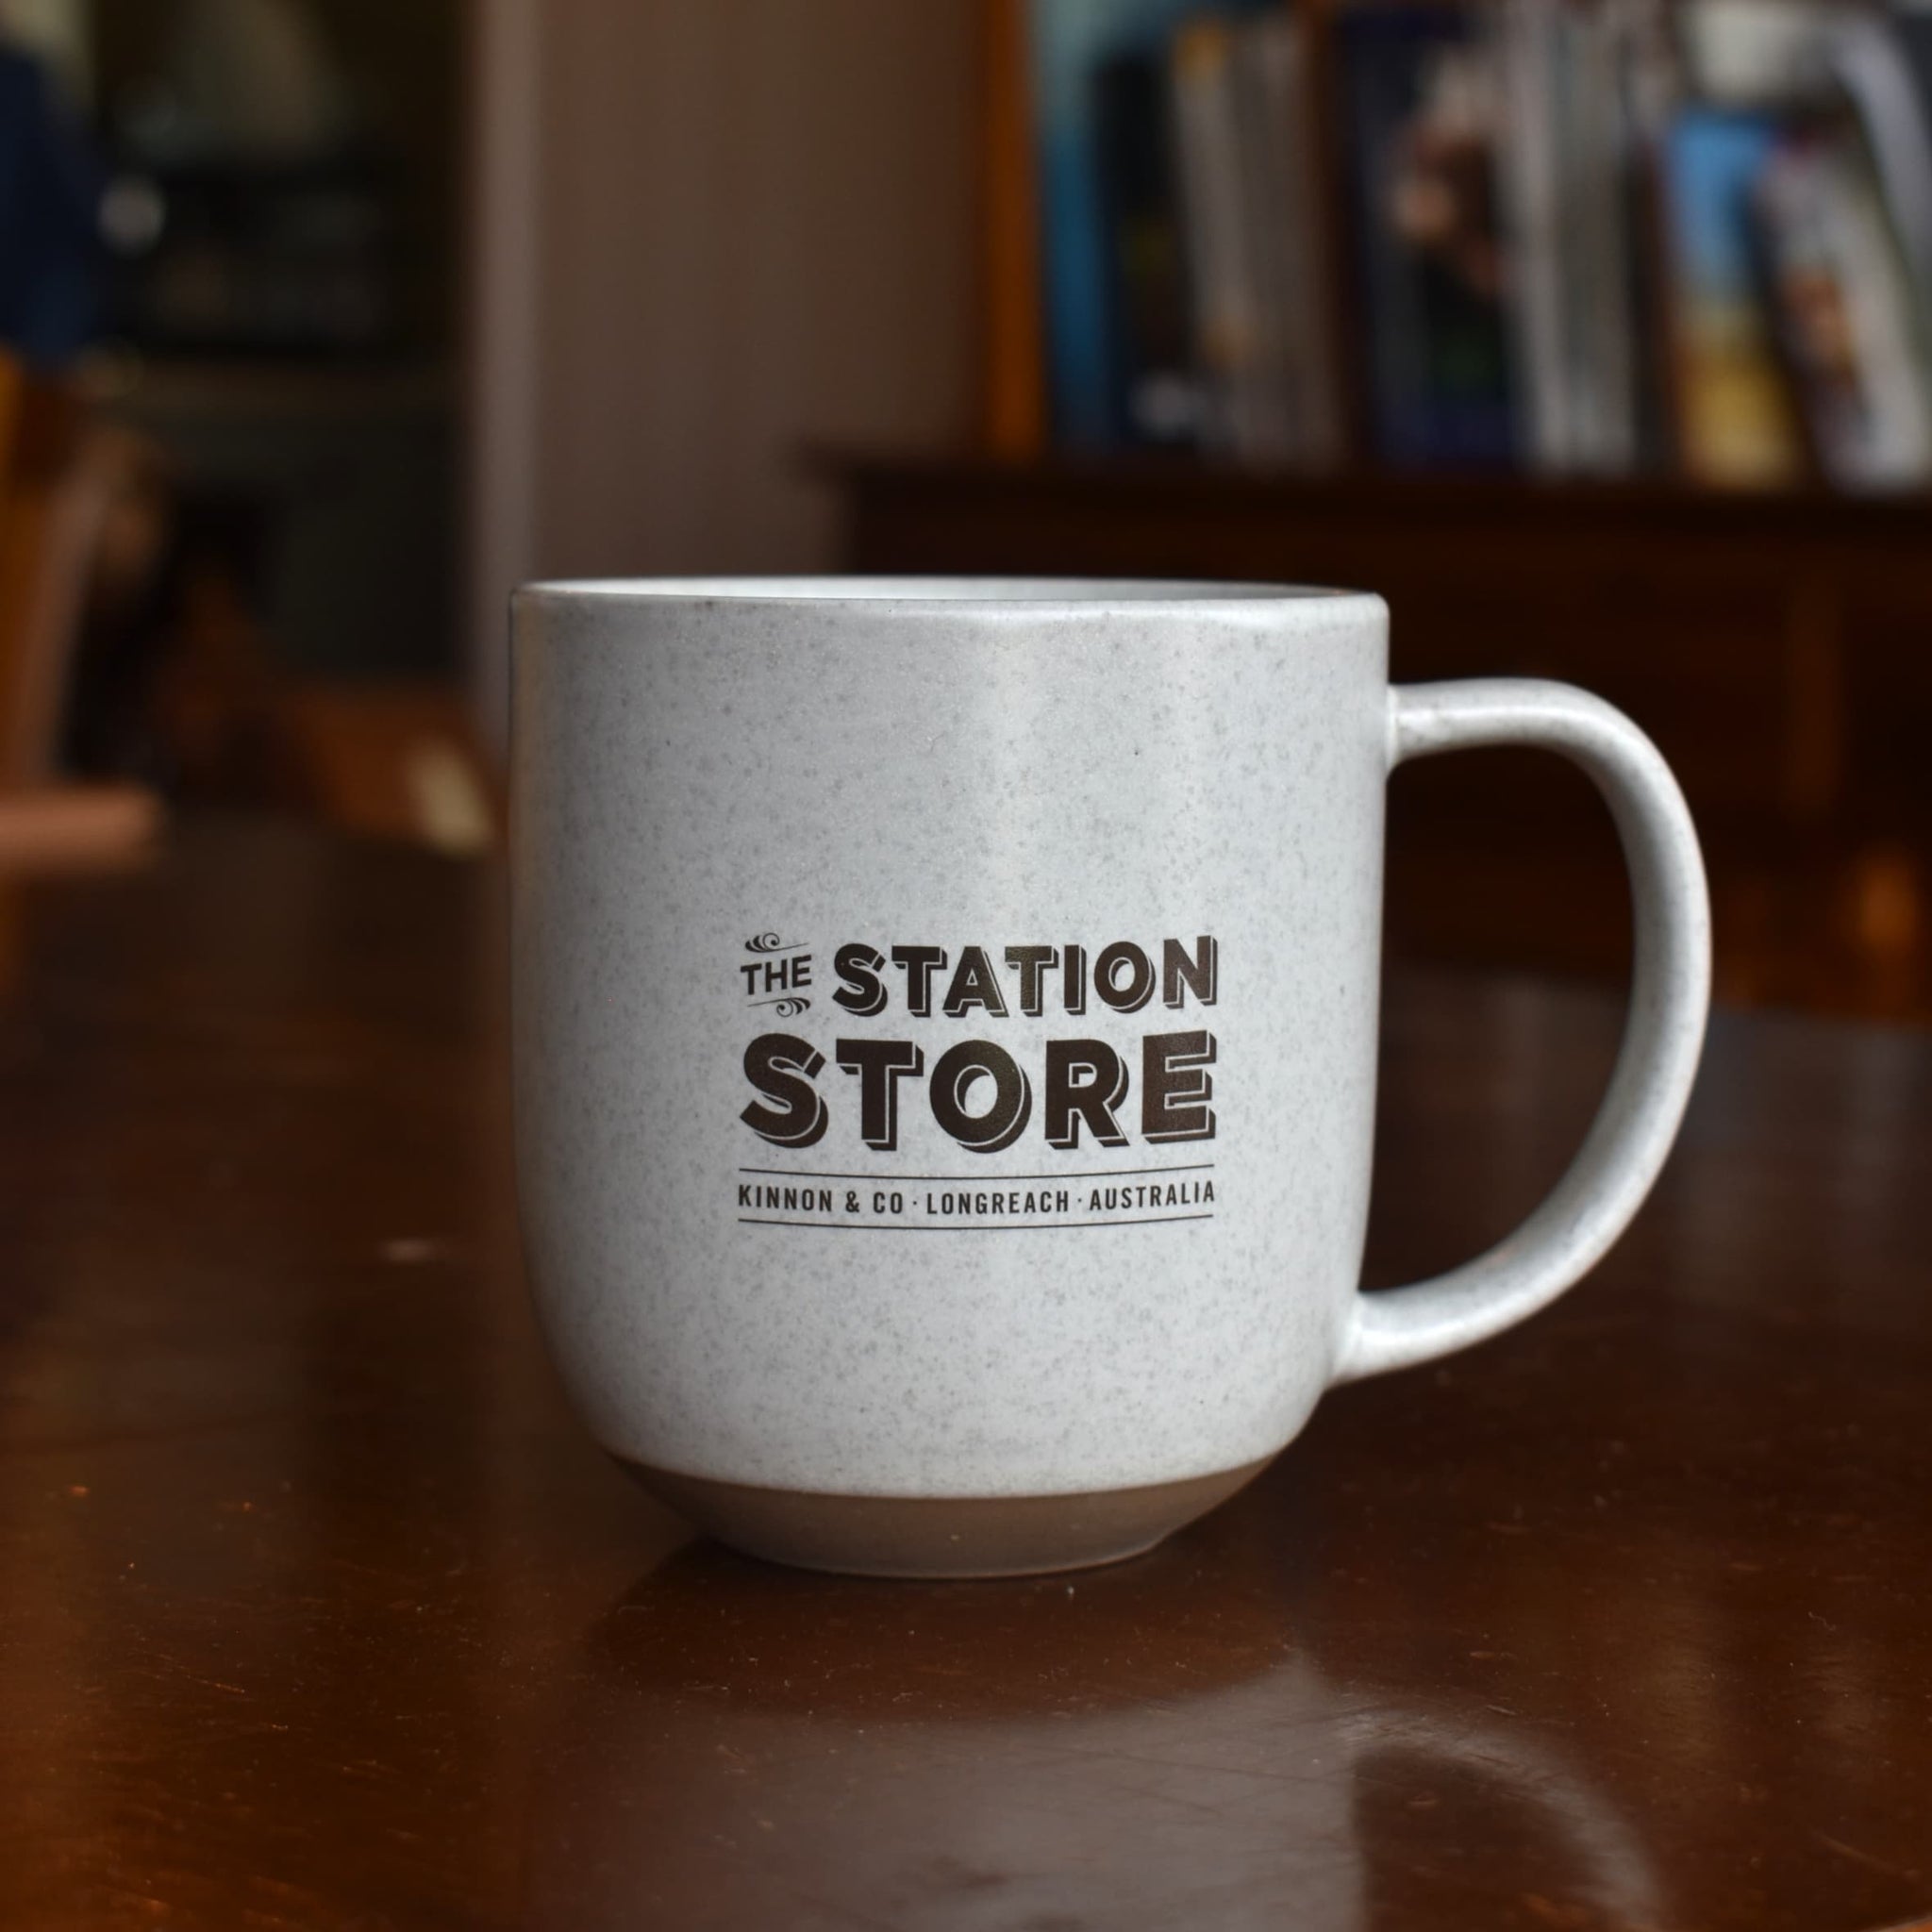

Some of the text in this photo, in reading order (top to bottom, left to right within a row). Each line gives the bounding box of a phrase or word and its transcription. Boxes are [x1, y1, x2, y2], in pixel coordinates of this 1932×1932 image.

[740, 935, 1218, 1018] THE STATION
[739, 1030, 1217, 1154] STORE
[738, 1181, 1215, 1215] KINNON & CO LONGREACH AUSTRALIA
